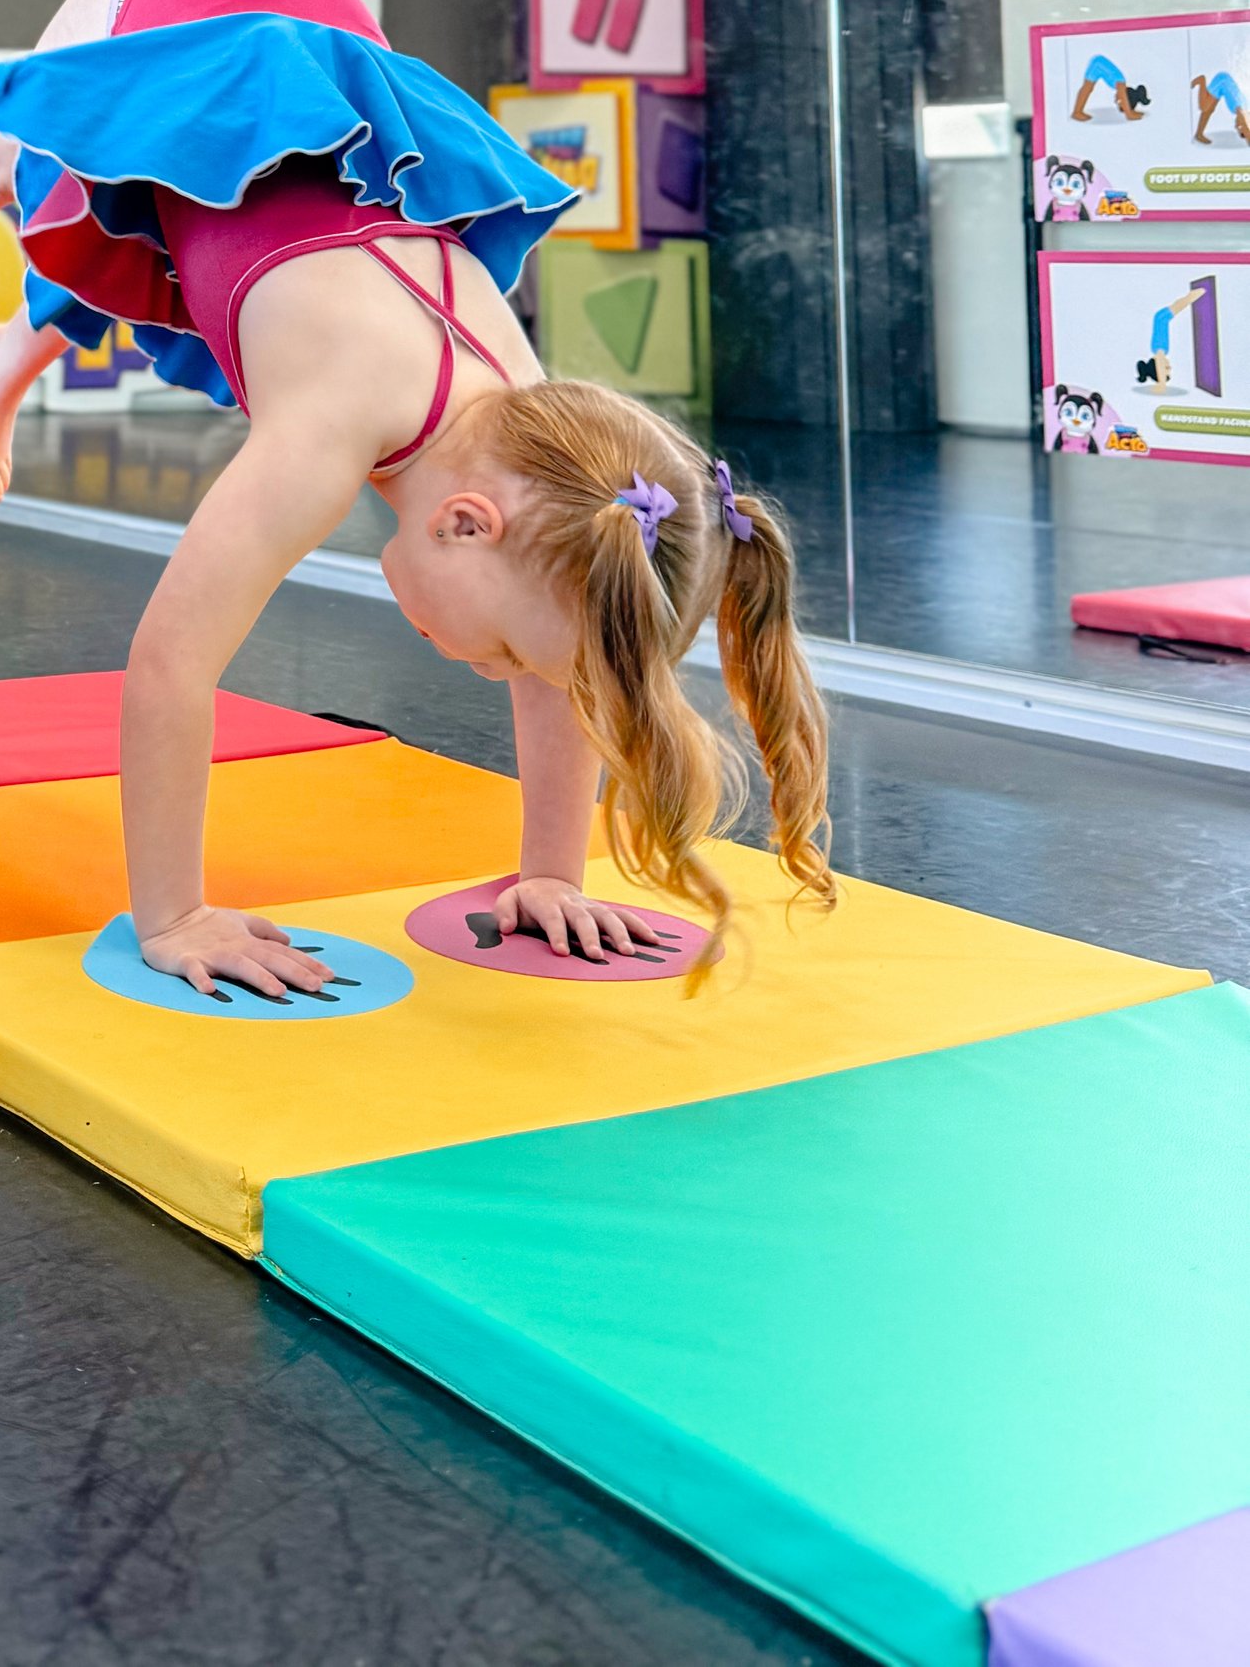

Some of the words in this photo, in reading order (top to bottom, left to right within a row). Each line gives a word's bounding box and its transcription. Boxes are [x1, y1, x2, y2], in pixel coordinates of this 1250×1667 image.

[1150, 174, 1180, 184] FOOT
[1181, 173, 1199, 184] UP
[1199, 173, 1231, 183] FOOT
